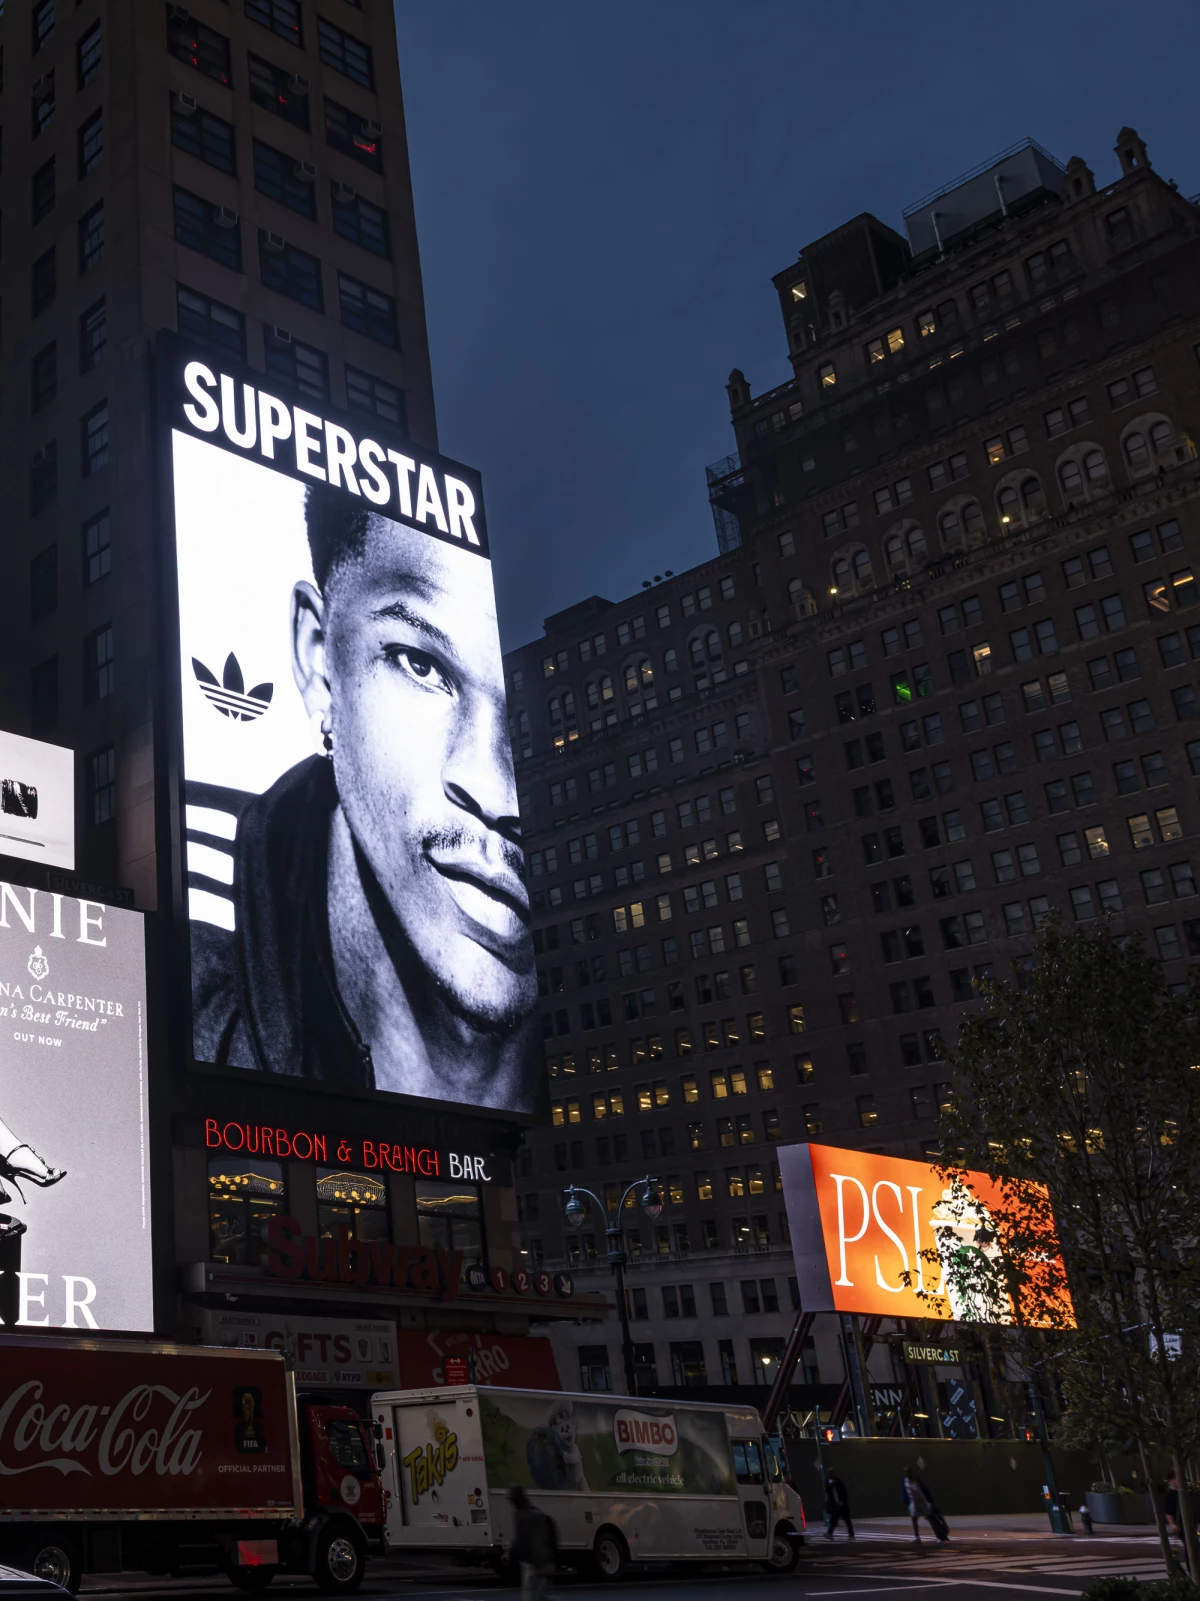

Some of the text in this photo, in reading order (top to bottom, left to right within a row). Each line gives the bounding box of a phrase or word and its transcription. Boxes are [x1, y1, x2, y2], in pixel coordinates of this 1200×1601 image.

[183, 361, 480, 546] SUPERSTAR
[30, 985, 124, 1017] CARPENTER
[21, 1005, 51, 1025] Best
[13, 1032, 62, 1047] OUT NOW
[205, 1118, 492, 1182] BOURBON & BRANCH BAR
[830, 1173, 947, 1296] PSL
[267, 1214, 463, 1303] Subway
[497, 1271, 504, 1288] 1
[518, 1273, 528, 1290] 2
[540, 1275, 548, 1291] 3
[908, 1346, 959, 1362] SILVERCAST
[342, 1373, 361, 1381] NYPD
[617, 1420, 675, 1445] BIMBO
[243, 1440, 259, 1449] FIFA
[218, 1465, 286, 1473] OFFICIAL PARTNER
[616, 1472, 685, 1486] all electric vehicle
